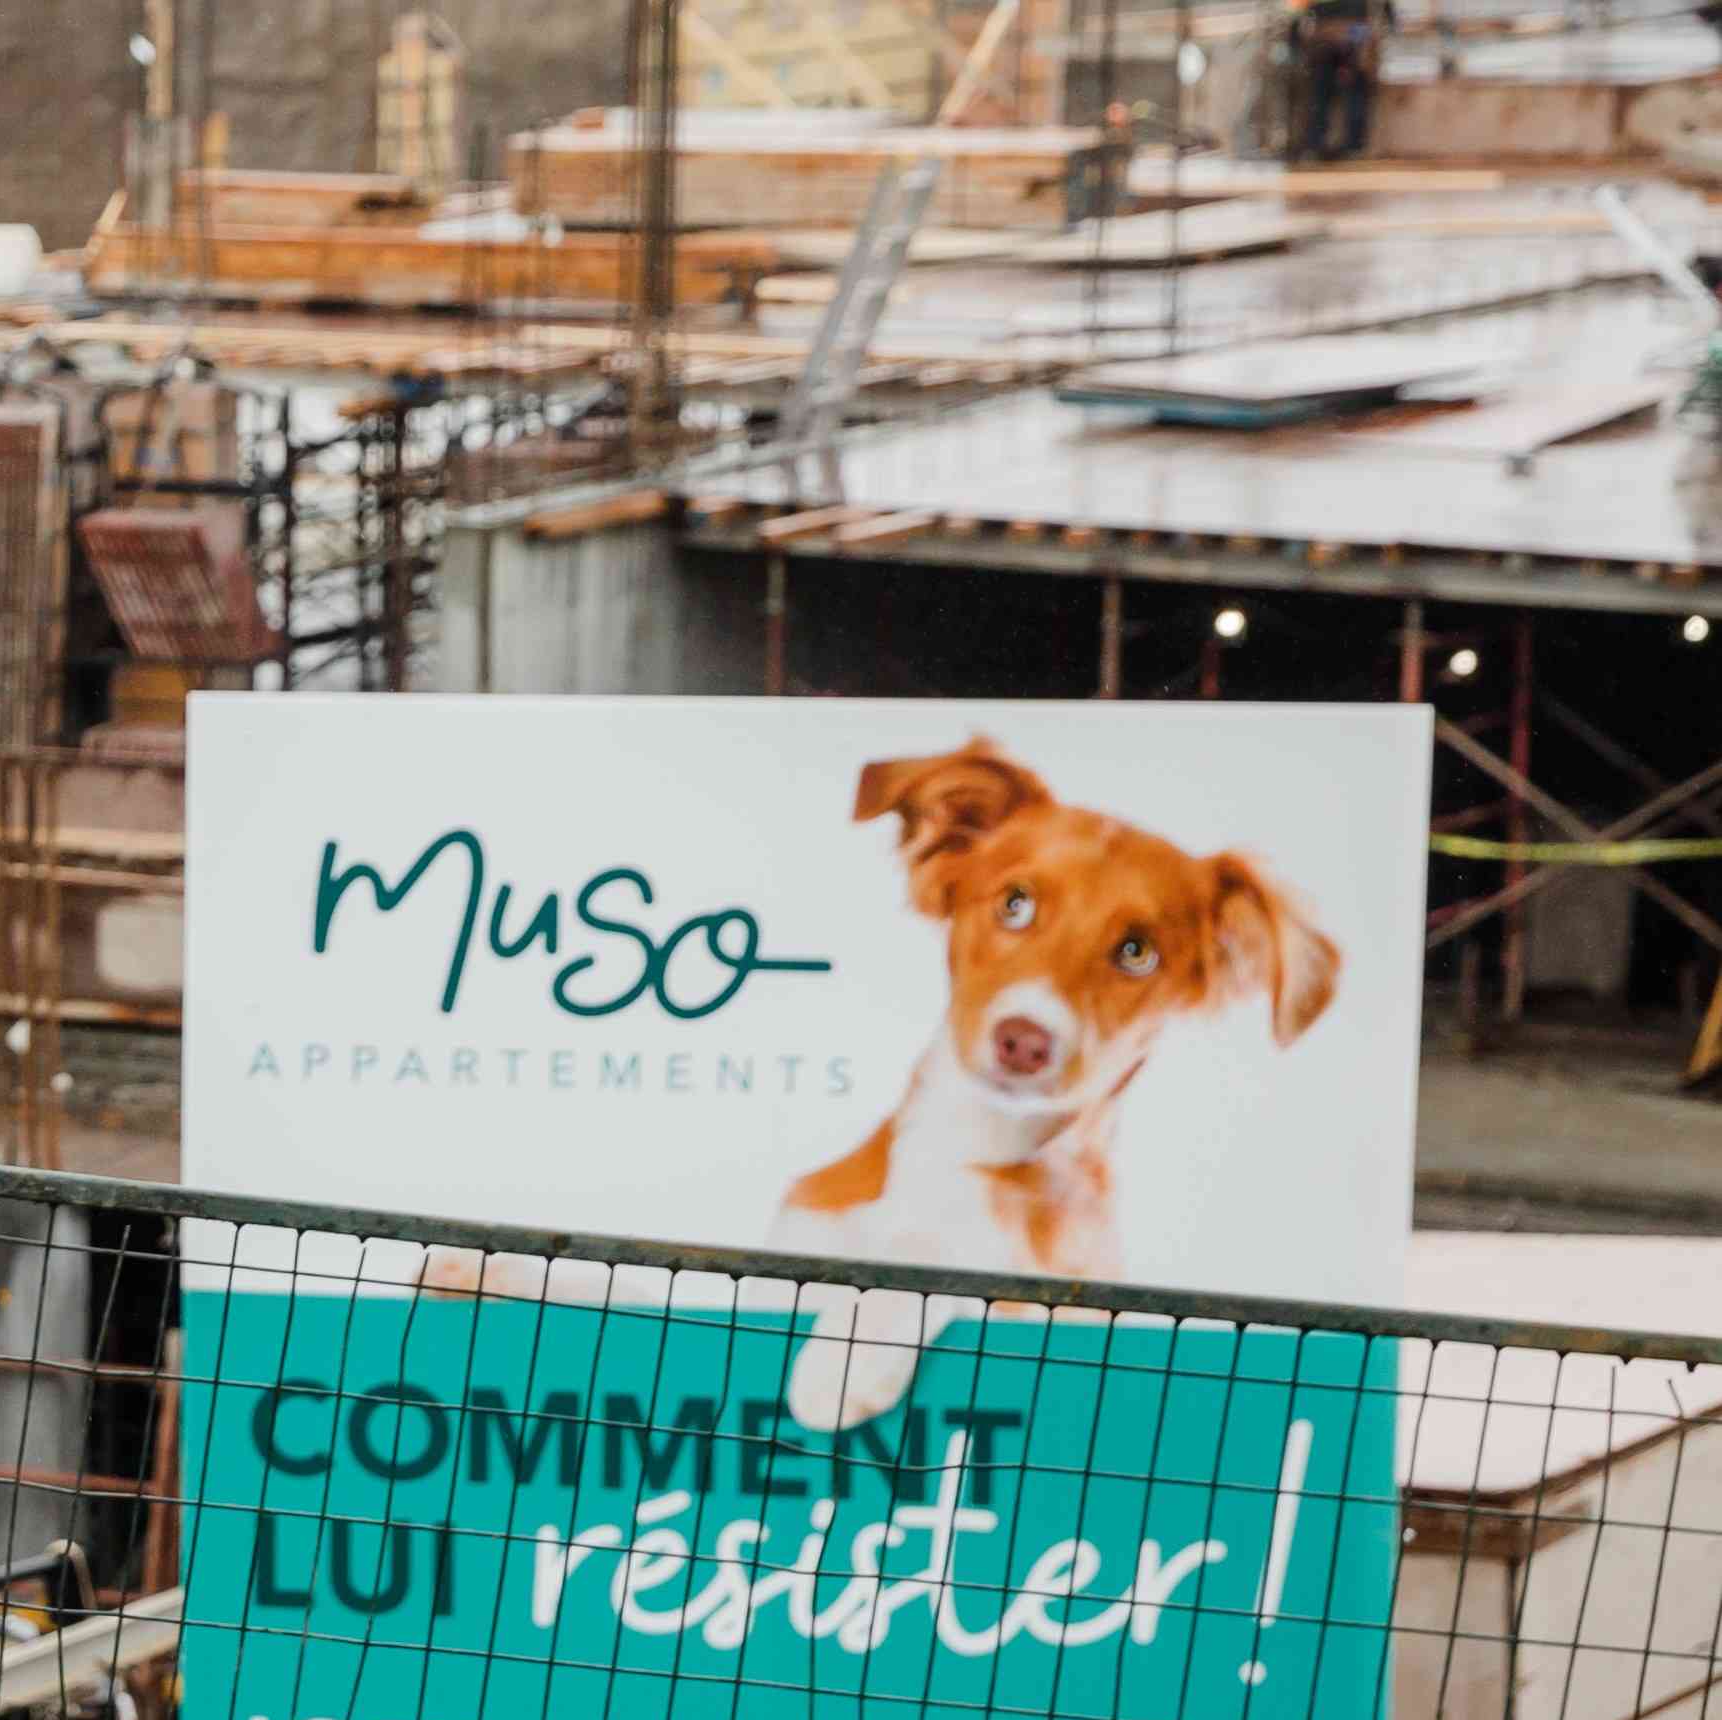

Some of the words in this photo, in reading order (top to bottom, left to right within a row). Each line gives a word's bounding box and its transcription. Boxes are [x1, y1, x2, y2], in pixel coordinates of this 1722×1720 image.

[247, 1042, 855, 1098] APPARTEMENTS
[251, 1377, 1024, 1507] COMMENT
[255, 1510, 455, 1617] LUI
